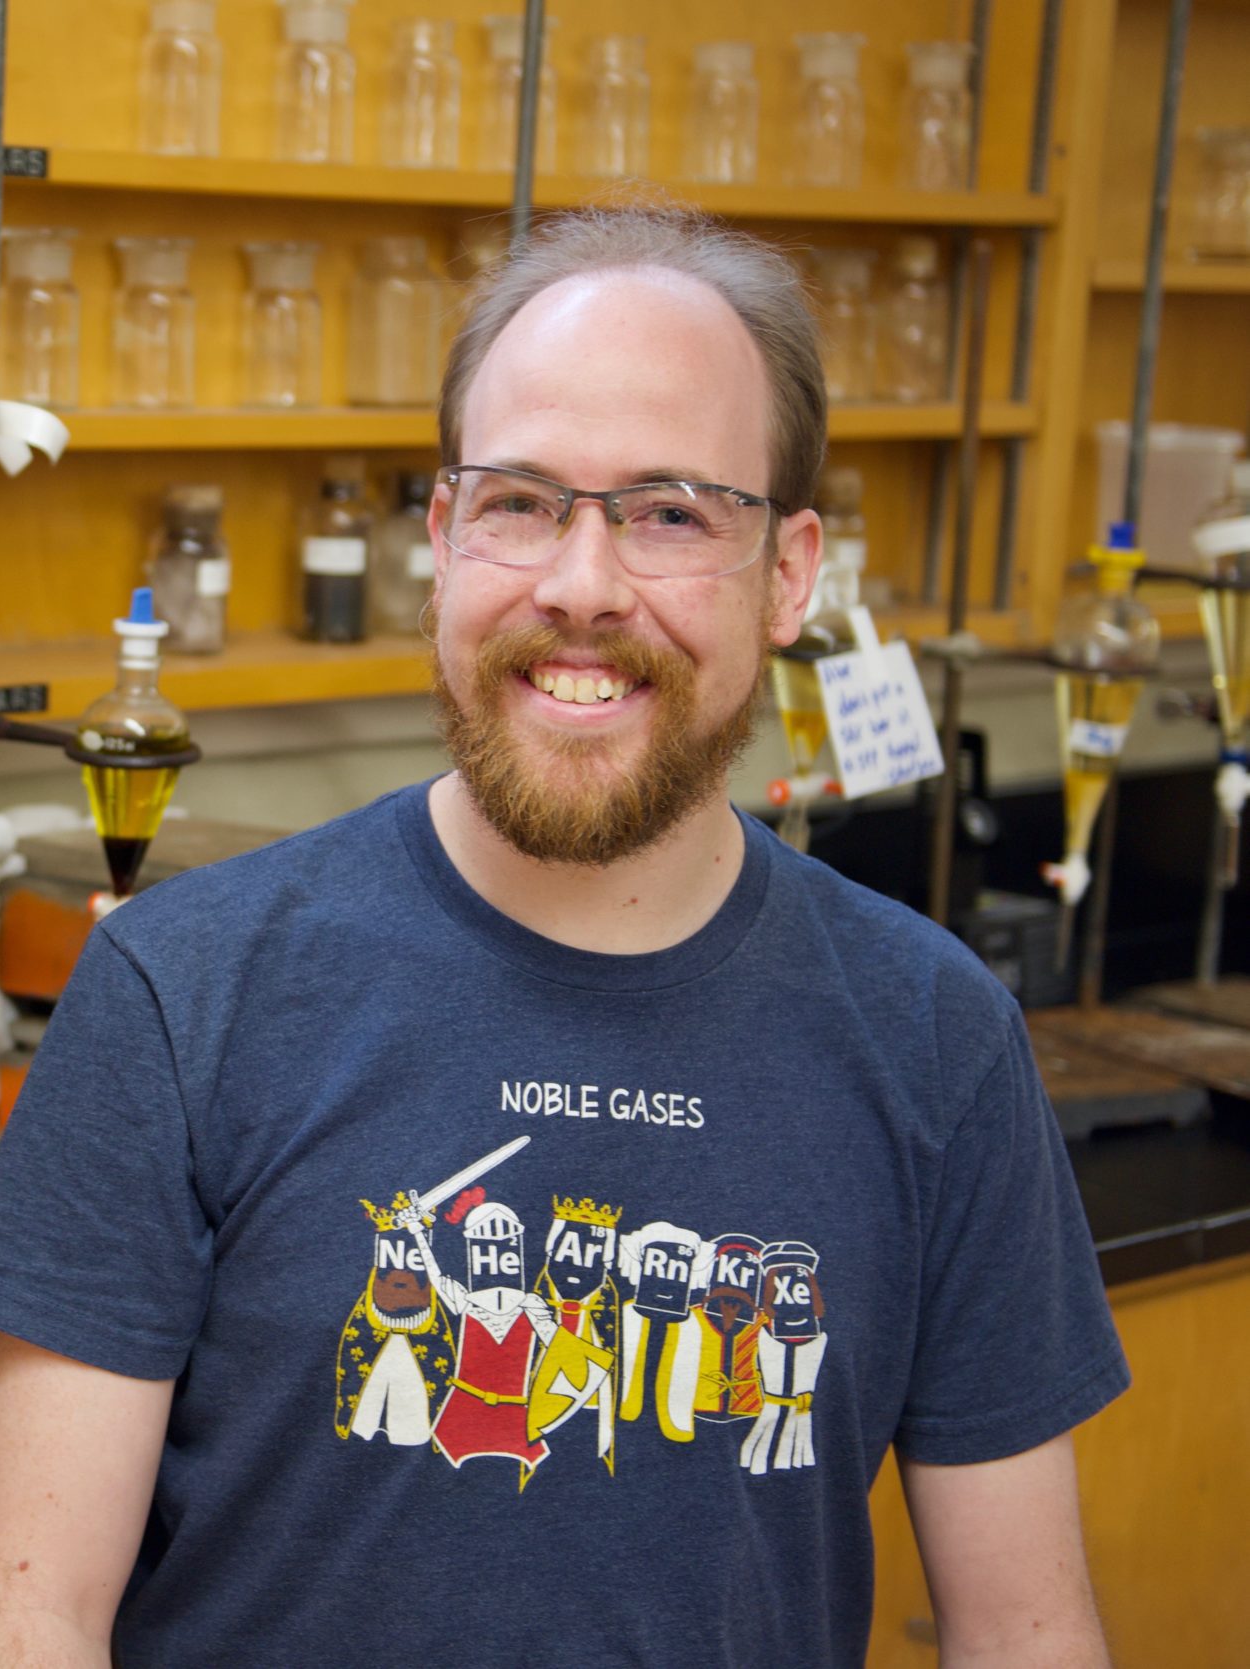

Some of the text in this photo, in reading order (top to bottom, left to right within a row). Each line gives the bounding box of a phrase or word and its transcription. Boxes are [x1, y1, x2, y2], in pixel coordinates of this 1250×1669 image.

[501, 1081, 705, 1128] NOBLE GASES
[509, 1236, 518, 1247] 2
[590, 1225, 605, 1238] 18
[378, 1239, 427, 1271] Ne
[471, 1245, 520, 1275] He
[554, 1231, 603, 1268] Ar
[643, 1247, 689, 1283] Rn
[677, 1245, 693, 1257] 86
[716, 1254, 755, 1288] Kr
[773, 1275, 811, 1305] Xe
